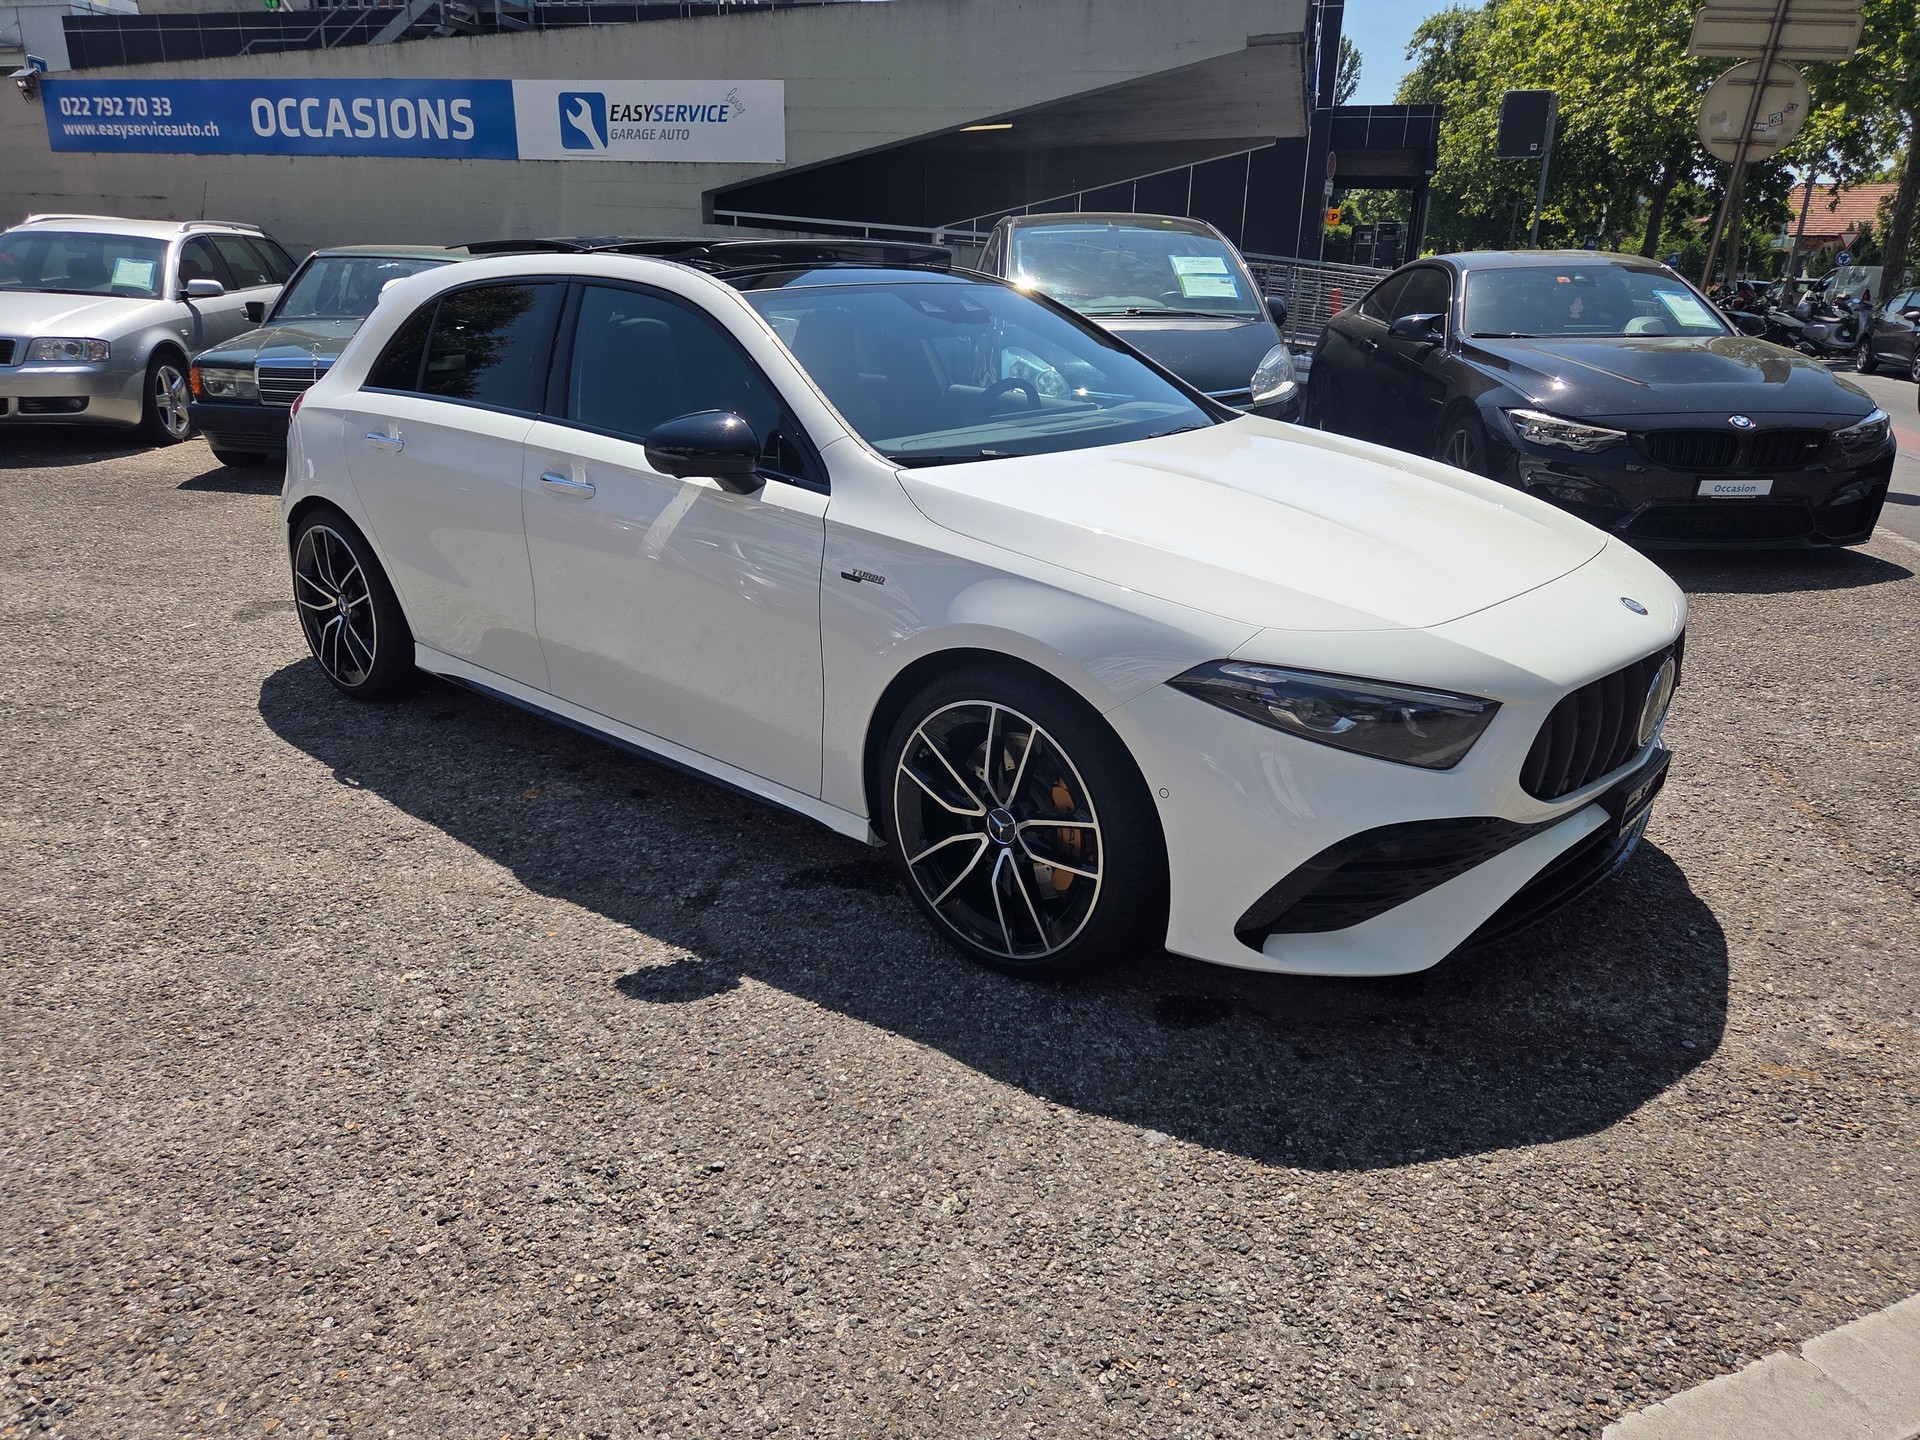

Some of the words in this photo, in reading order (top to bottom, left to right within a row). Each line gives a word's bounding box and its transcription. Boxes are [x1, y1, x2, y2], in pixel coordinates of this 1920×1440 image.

[60, 97, 91, 116] 022
[92, 97, 124, 116] 792
[126, 97, 148, 116] 70
[151, 97, 172, 116] 33
[609, 104, 729, 122] EASYSERVICE
[250, 97, 475, 140] OCCASIONS
[63, 121, 219, 139] www.easyserviceauto.ch
[610, 128, 656, 140] GARAGE
[658, 128, 690, 140] AUTO
[1714, 484, 1757, 492] Occasion
